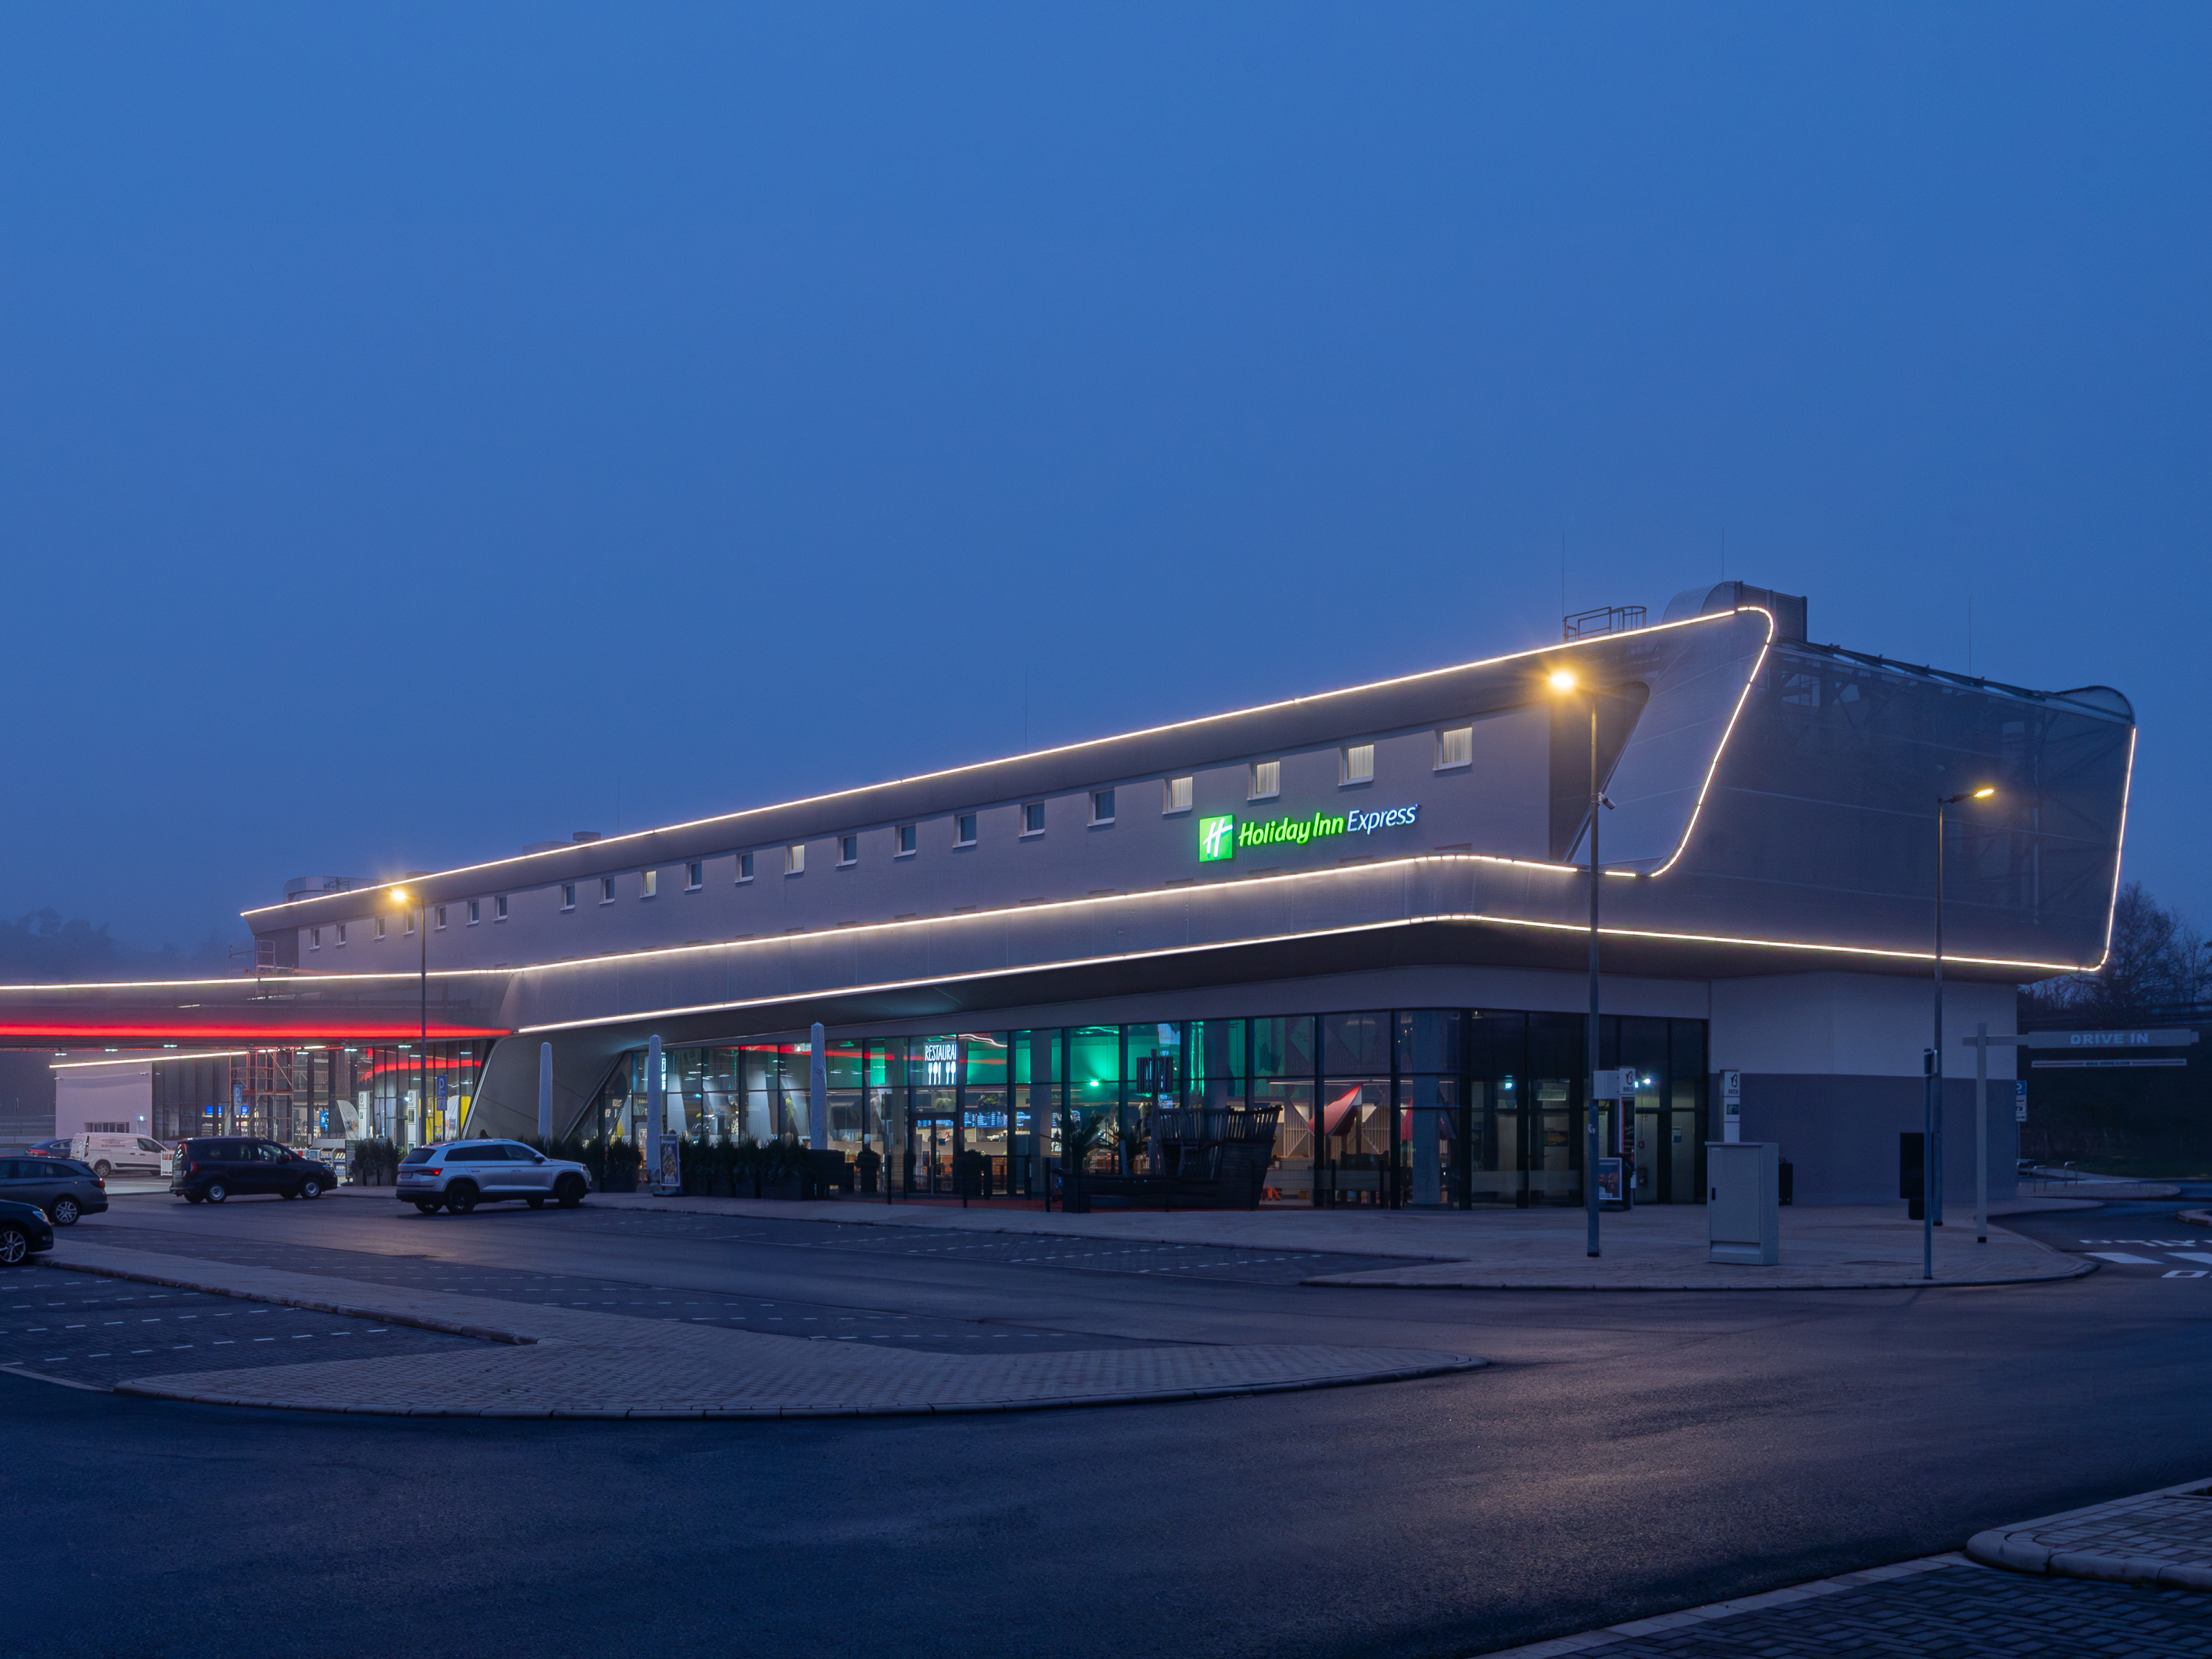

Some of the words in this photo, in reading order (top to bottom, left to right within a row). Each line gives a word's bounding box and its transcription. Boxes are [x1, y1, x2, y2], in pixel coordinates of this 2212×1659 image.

[1238, 816, 1310, 846] Holiday
[1313, 812, 1344, 836] Inn
[1347, 806, 1416, 835] Express
[2070, 1033, 2124, 1045] DRIVE
[2130, 1032, 2149, 1044] IN
